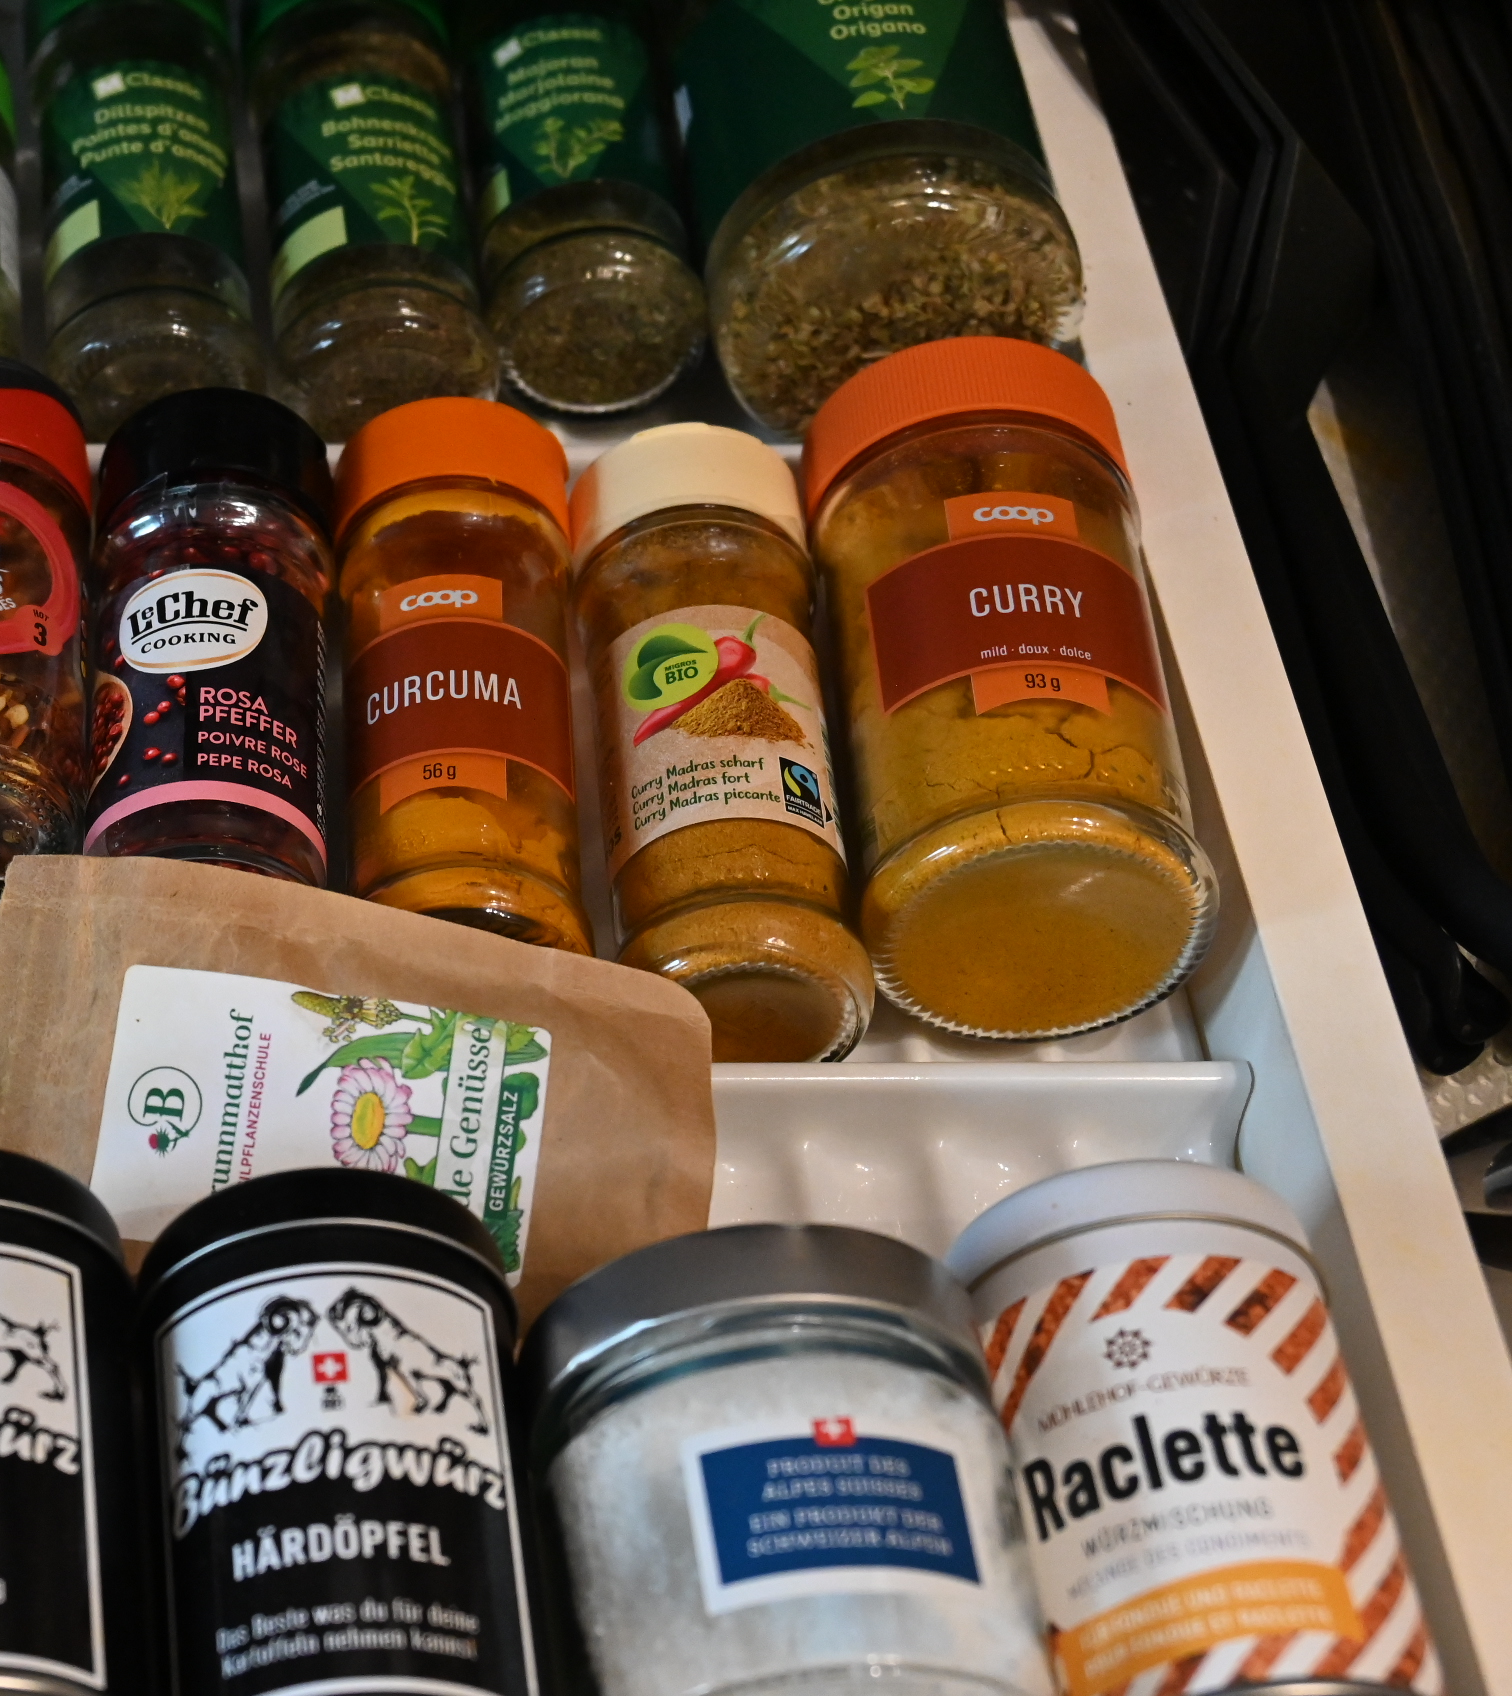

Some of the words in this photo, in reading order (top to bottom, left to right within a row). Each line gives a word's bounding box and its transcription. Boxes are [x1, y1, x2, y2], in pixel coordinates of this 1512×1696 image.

[830, 18, 927, 40] Origano
[832, 3, 914, 21] Origan
[81, 142, 144, 169] Punte
[973, 505, 1054, 525] coop
[33, 608, 50, 622] HOT
[400, 589, 479, 612] coop
[969, 583, 1083, 618] CURRY
[34, 623, 47, 646] 3
[140, 632, 237, 654] COOKING
[980, 645, 1008, 659] mild
[1018, 643, 1049, 655] doux
[1059, 645, 1092, 660] dolce
[664, 659, 697, 672] MIGROS
[665, 666, 699, 685] BIO
[1024, 673, 1047, 689] 93
[1051, 677, 1061, 692] g
[199, 687, 269, 715] ROSA
[367, 669, 522, 725] CURCUMA
[199, 705, 299, 749] PFEFFER
[197, 731, 267, 755] POIVRE
[271, 745, 308, 779] ROSE
[197, 753, 243, 770] PEPE
[248, 761, 294, 790] ROSA
[423, 763, 443, 781] 56
[446, 765, 456, 780] g
[631, 778, 663, 799] Curry
[666, 760, 716, 780] Madras
[720, 754, 765, 771] scharf
[632, 791, 665, 815] Curry
[668, 777, 717, 795] Madras
[722, 773, 751, 786] fort
[634, 808, 666, 831] Curry
[670, 792, 720, 811] Madras
[724, 789, 781, 805] piccante
[786, 794, 823, 816] FAIRTRADE
[144, 1087, 185, 1123] B
[210, 1009, 254, 1194] runnmatthof
[238, 1032, 272, 1182] ILPFLANZENSCHULE
[449, 1025, 493, 1163] Genüsse
[488, 1090, 519, 1211] GEWÜRZSALZ
[173, 1431, 507, 1539] Bünzligwürz
[1023, 1410, 1306, 1542] Raclette
[232, 1512, 452, 1582] HÄRDÖPFEL
